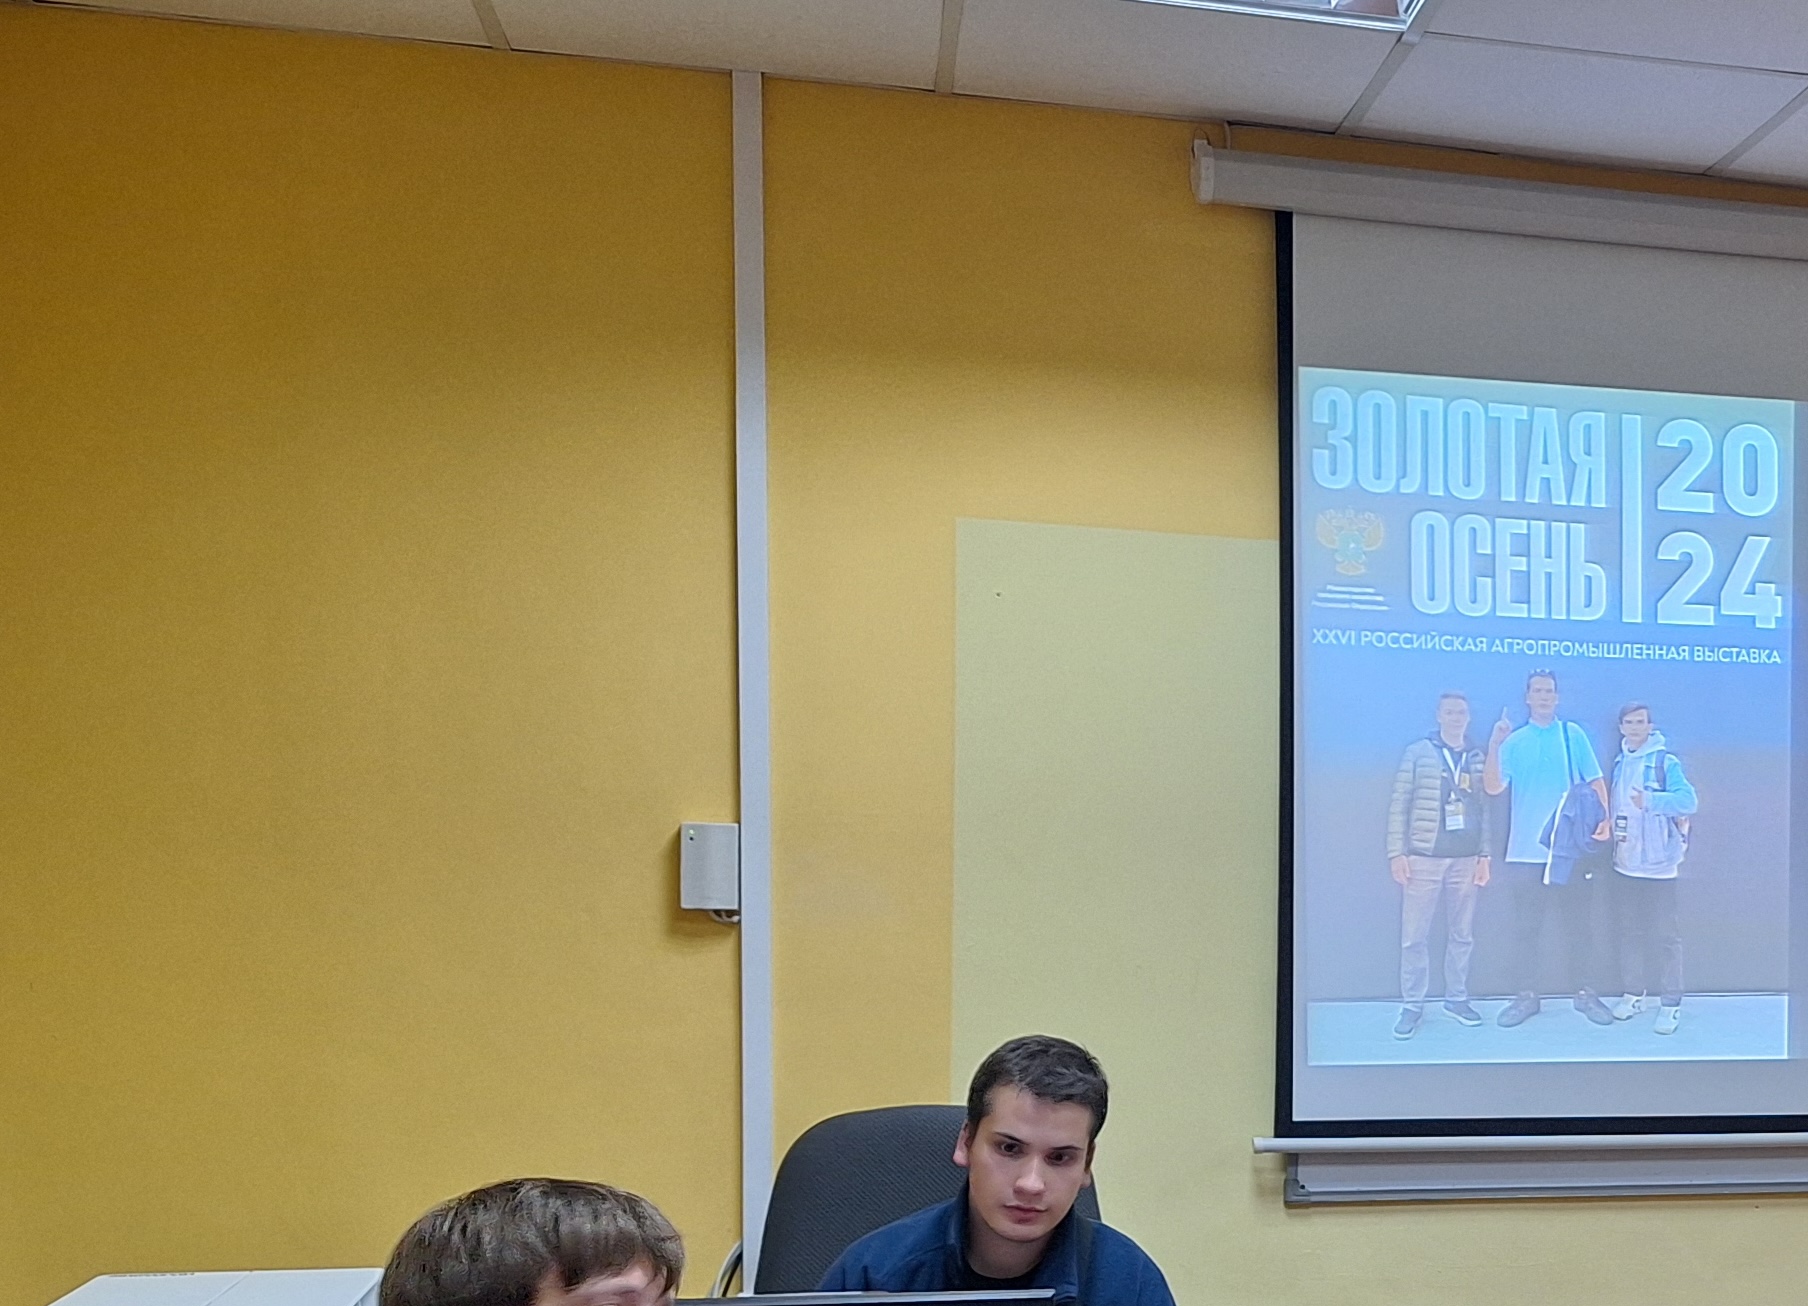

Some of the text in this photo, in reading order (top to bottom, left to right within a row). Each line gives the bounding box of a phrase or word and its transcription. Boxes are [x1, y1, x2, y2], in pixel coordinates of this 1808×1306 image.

[1312, 386, 1607, 508] ЗОЛОТАЯ
[1656, 418, 1779, 517] 20
[1410, 510, 1607, 621] ОСЕНЬ
[1656, 531, 1783, 630] 24
[1312, 628, 1782, 665] XXVI РОССИЙСКАЯ АГРОПРОМЫШЛЕННАЯ ВЫСТАВКА
